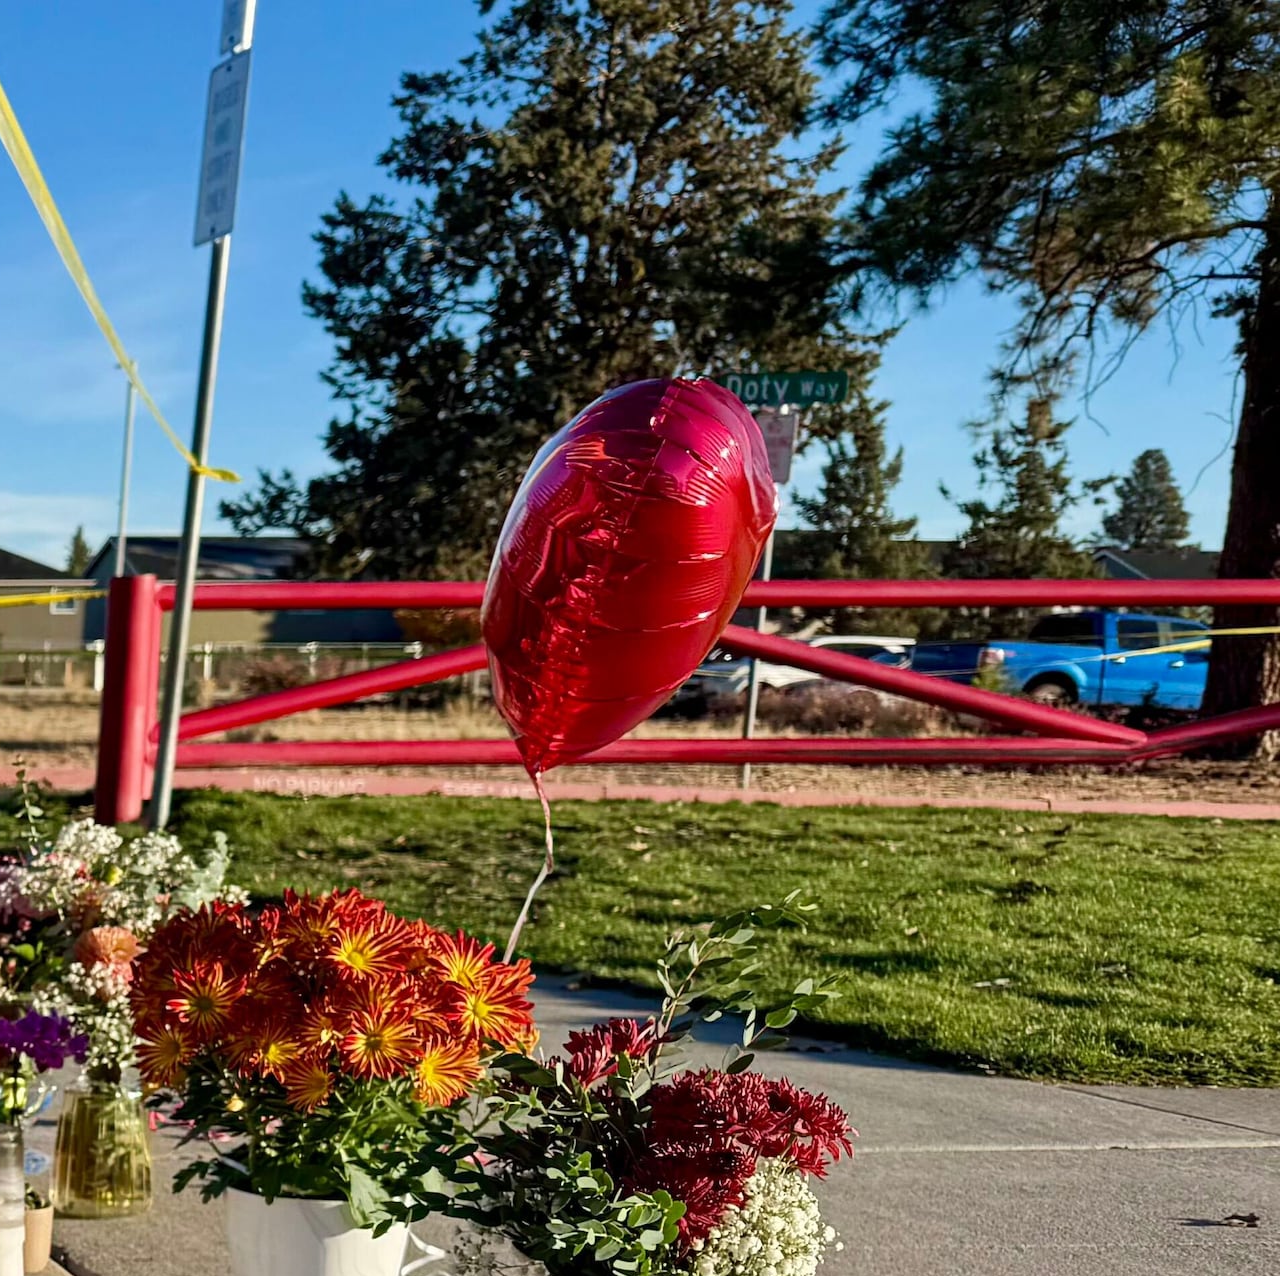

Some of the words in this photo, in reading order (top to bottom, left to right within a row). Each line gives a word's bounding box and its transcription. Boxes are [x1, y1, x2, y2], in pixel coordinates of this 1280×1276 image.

[726, 375, 790, 402] Doty
[253, 775, 281, 791] NO
[286, 775, 366, 796] PARKING
